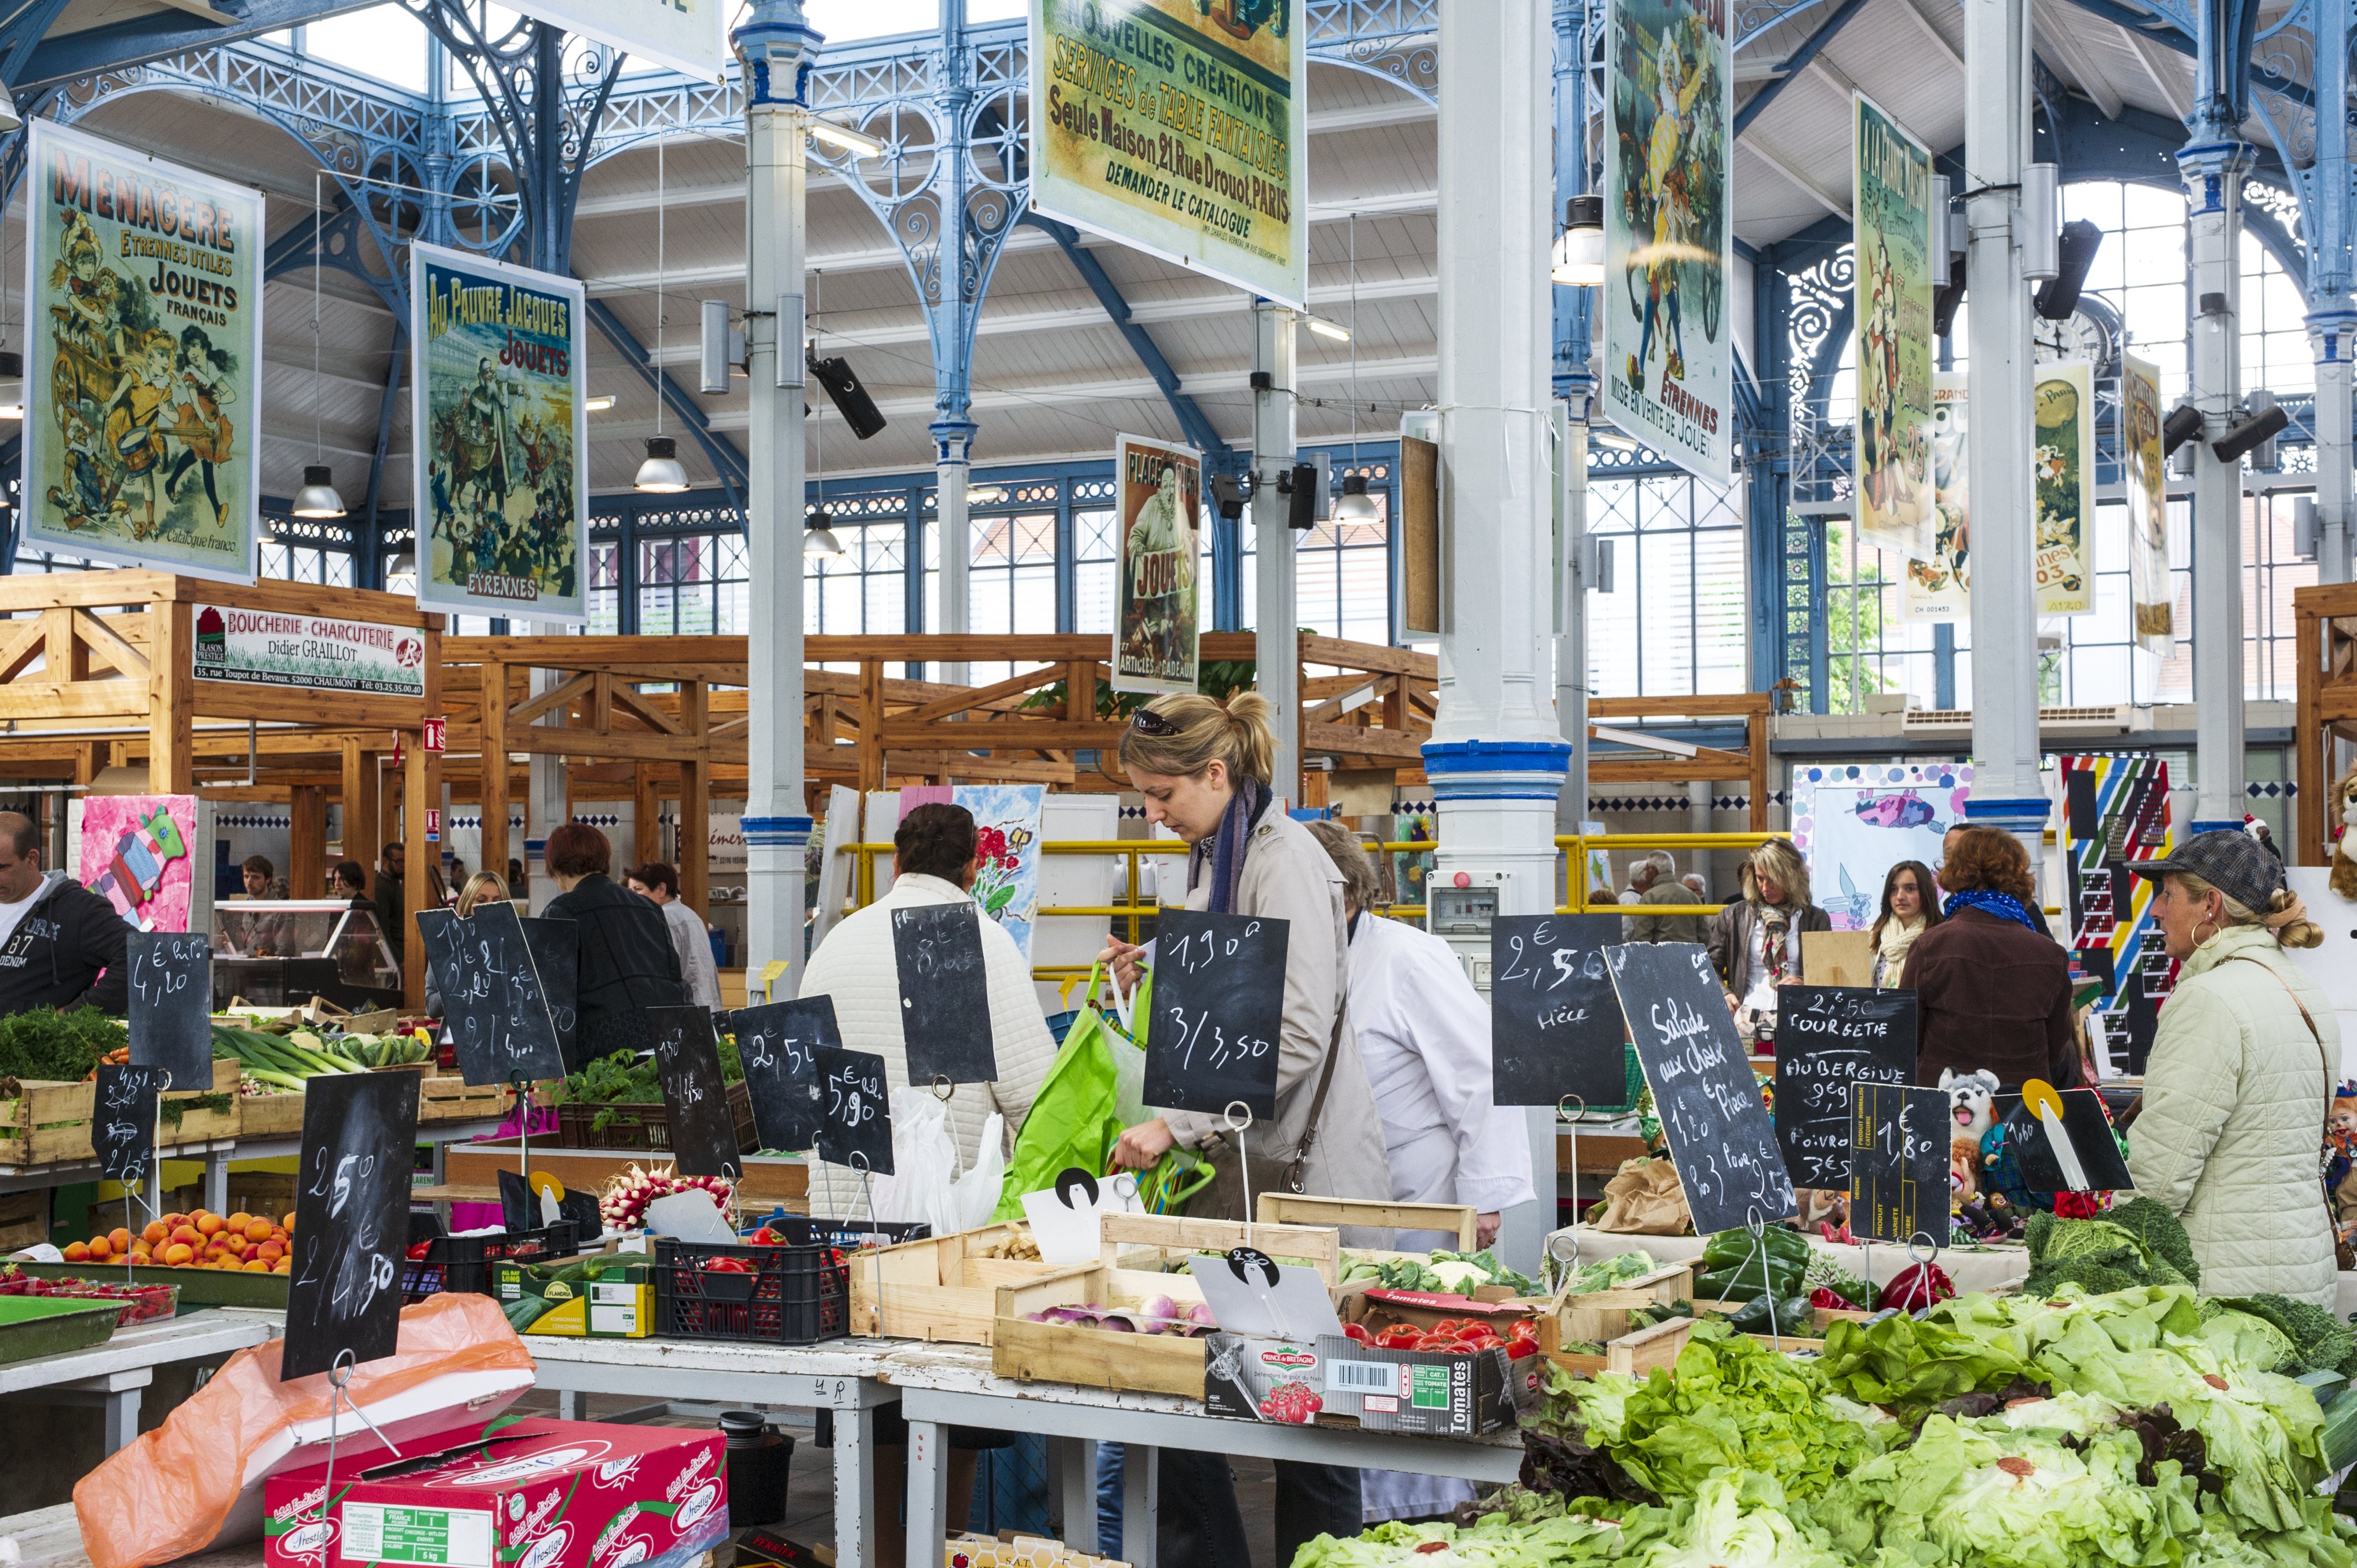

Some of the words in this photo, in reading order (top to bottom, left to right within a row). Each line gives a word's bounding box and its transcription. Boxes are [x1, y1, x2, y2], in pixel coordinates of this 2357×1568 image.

[1049, 85, 1099, 141] Seule
[1053, 32, 1137, 110] SERVICES
[1139, 82, 1156, 120] de
[1158, 81, 1205, 142] TABLE
[1207, 105, 1287, 181] FANTAISIES
[1105, 160, 1170, 205] DEMANDER
[1172, 188, 1186, 211] LE
[1188, 194, 1252, 239] CATALOGUE
[189, 248, 232, 277] UTILES
[149, 261, 238, 312] JOUETS
[166, 299, 227, 328] FRANÇAIS
[429, 273, 448, 343] AU
[450, 277, 503, 330] PAUVRE
[505, 284, 567, 339] JACQUES
[499, 329, 568, 377] JOUETS
[1611, 375, 1628, 407] MISE
[1630, 389, 1639, 416] EN
[1641, 395, 1663, 430] VENTE
[1665, 412, 1675, 438] DE
[1678, 417, 1719, 461] JOUETS
[1127, 451, 1162, 486] PLACE
[166, 529, 208, 549] Catalogue
[207, 534, 236, 553] franco
[468, 573, 536, 599] ETRENNES
[1136, 552, 1191, 597] JOUETS
[228, 610, 302, 635] BOUCHERIE
[311, 620, 395, 653] CHARCUTERIE
[197, 650, 224, 661] PRESTIGE
[198, 642, 223, 653] BLASON
[268, 640, 300, 656] Didier
[302, 640, 357, 663] GRAILLOT
[1119, 654, 1155, 674] ARTICLES
[1162, 660, 1194, 679] CADEAUX
[209, 670, 223, 678] rue
[224, 669, 250, 682] Toupot
[251, 671, 261, 679] de
[291, 675, 313, 685] 52000
[313, 676, 357, 689] CHAUMONT
[374, 681, 421, 695] 03.25.35.00.40
[8, 935, 33, 956] 87
[1651, 996, 1710, 1046] Salade
[1659, 1057, 1685, 1083] aux
[1386, 1293, 1437, 1305] Tomates
[1263, 1354, 1281, 1362] PRINCE
[1287, 1355, 1314, 1364] BRETAGNE
[1289, 1373, 1301, 1382] goût
[1436, 1424, 1448, 1432] Les
[1450, 1361, 1466, 1433] Tomates
[685, 1490, 713, 1522] Prestige
[292, 1529, 330, 1549] Prestige
[527, 1534, 563, 1567] Prestige
[422, 1551, 428, 1559] 5
[429, 1552, 437, 1561] kg
